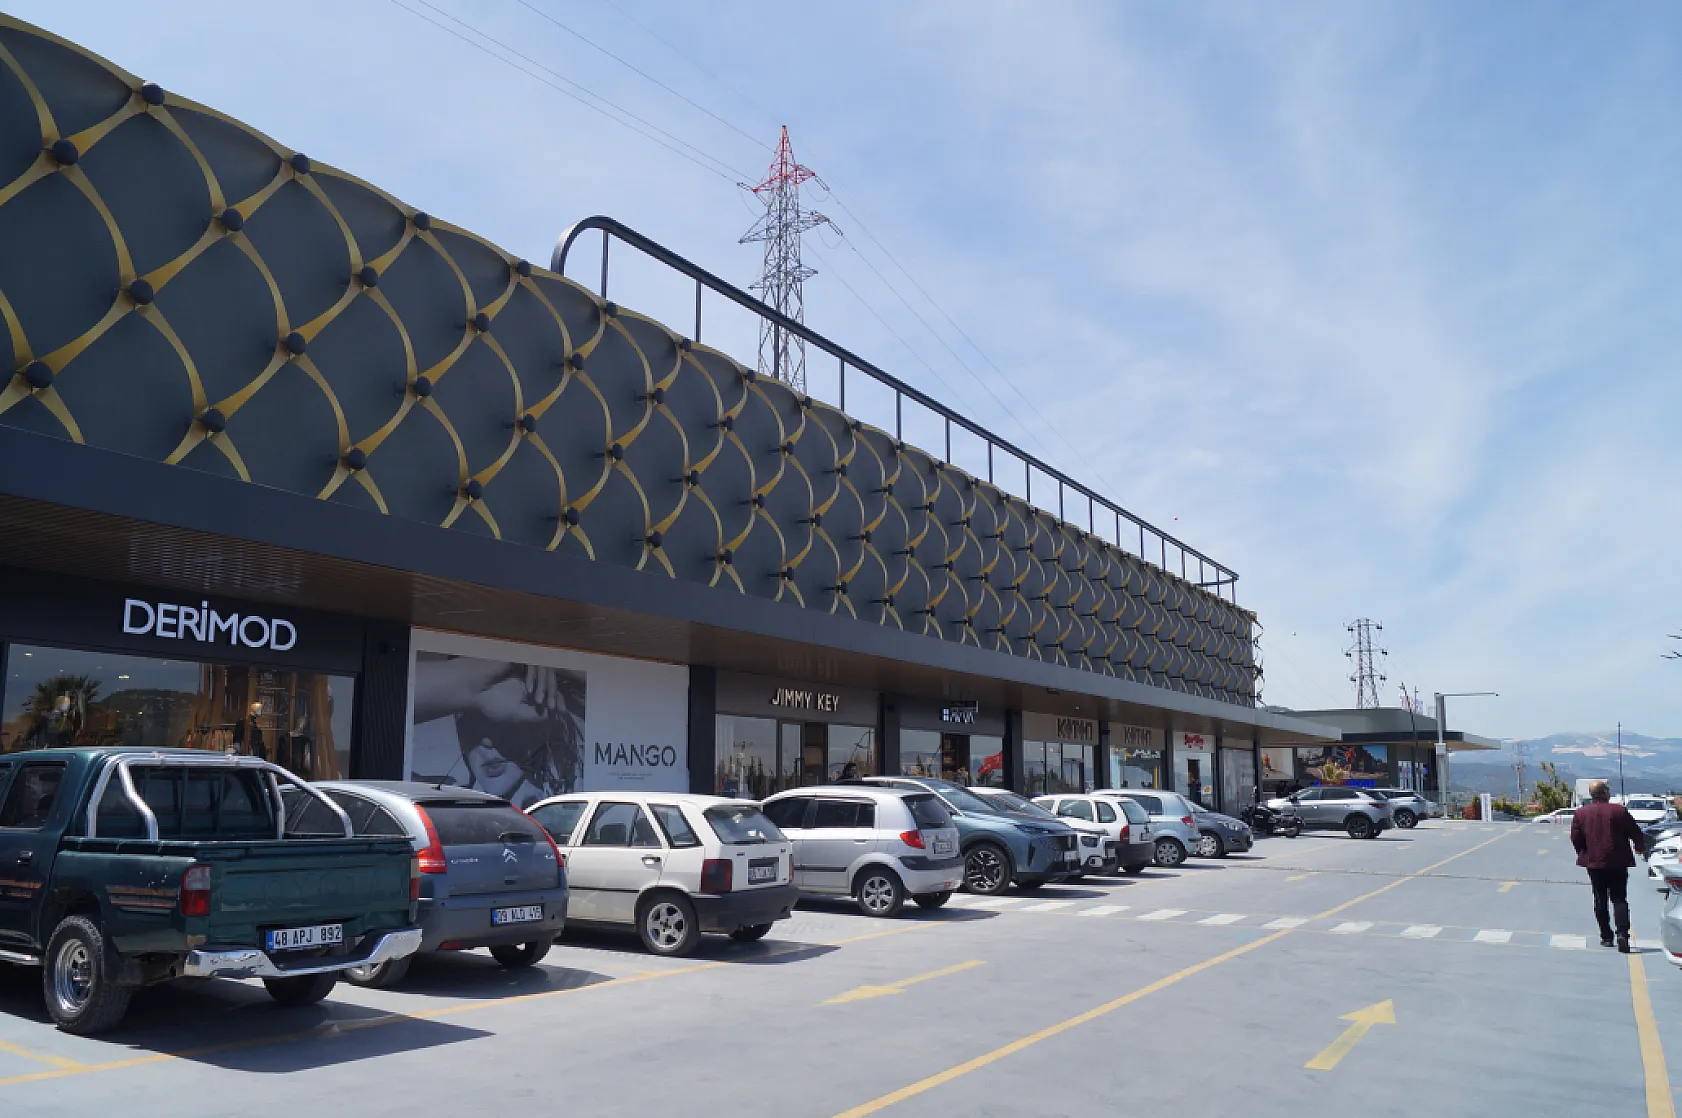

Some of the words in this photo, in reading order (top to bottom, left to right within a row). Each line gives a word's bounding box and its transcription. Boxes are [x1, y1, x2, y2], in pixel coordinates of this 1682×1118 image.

[124, 598, 297, 651] DERİMOD
[772, 688, 812, 710] JIMMY
[817, 692, 839, 712] KEY
[594, 742, 677, 768] MANGO
[274, 931, 288, 946] 48
[292, 928, 313, 945] APJ
[320, 925, 342, 941] 892
